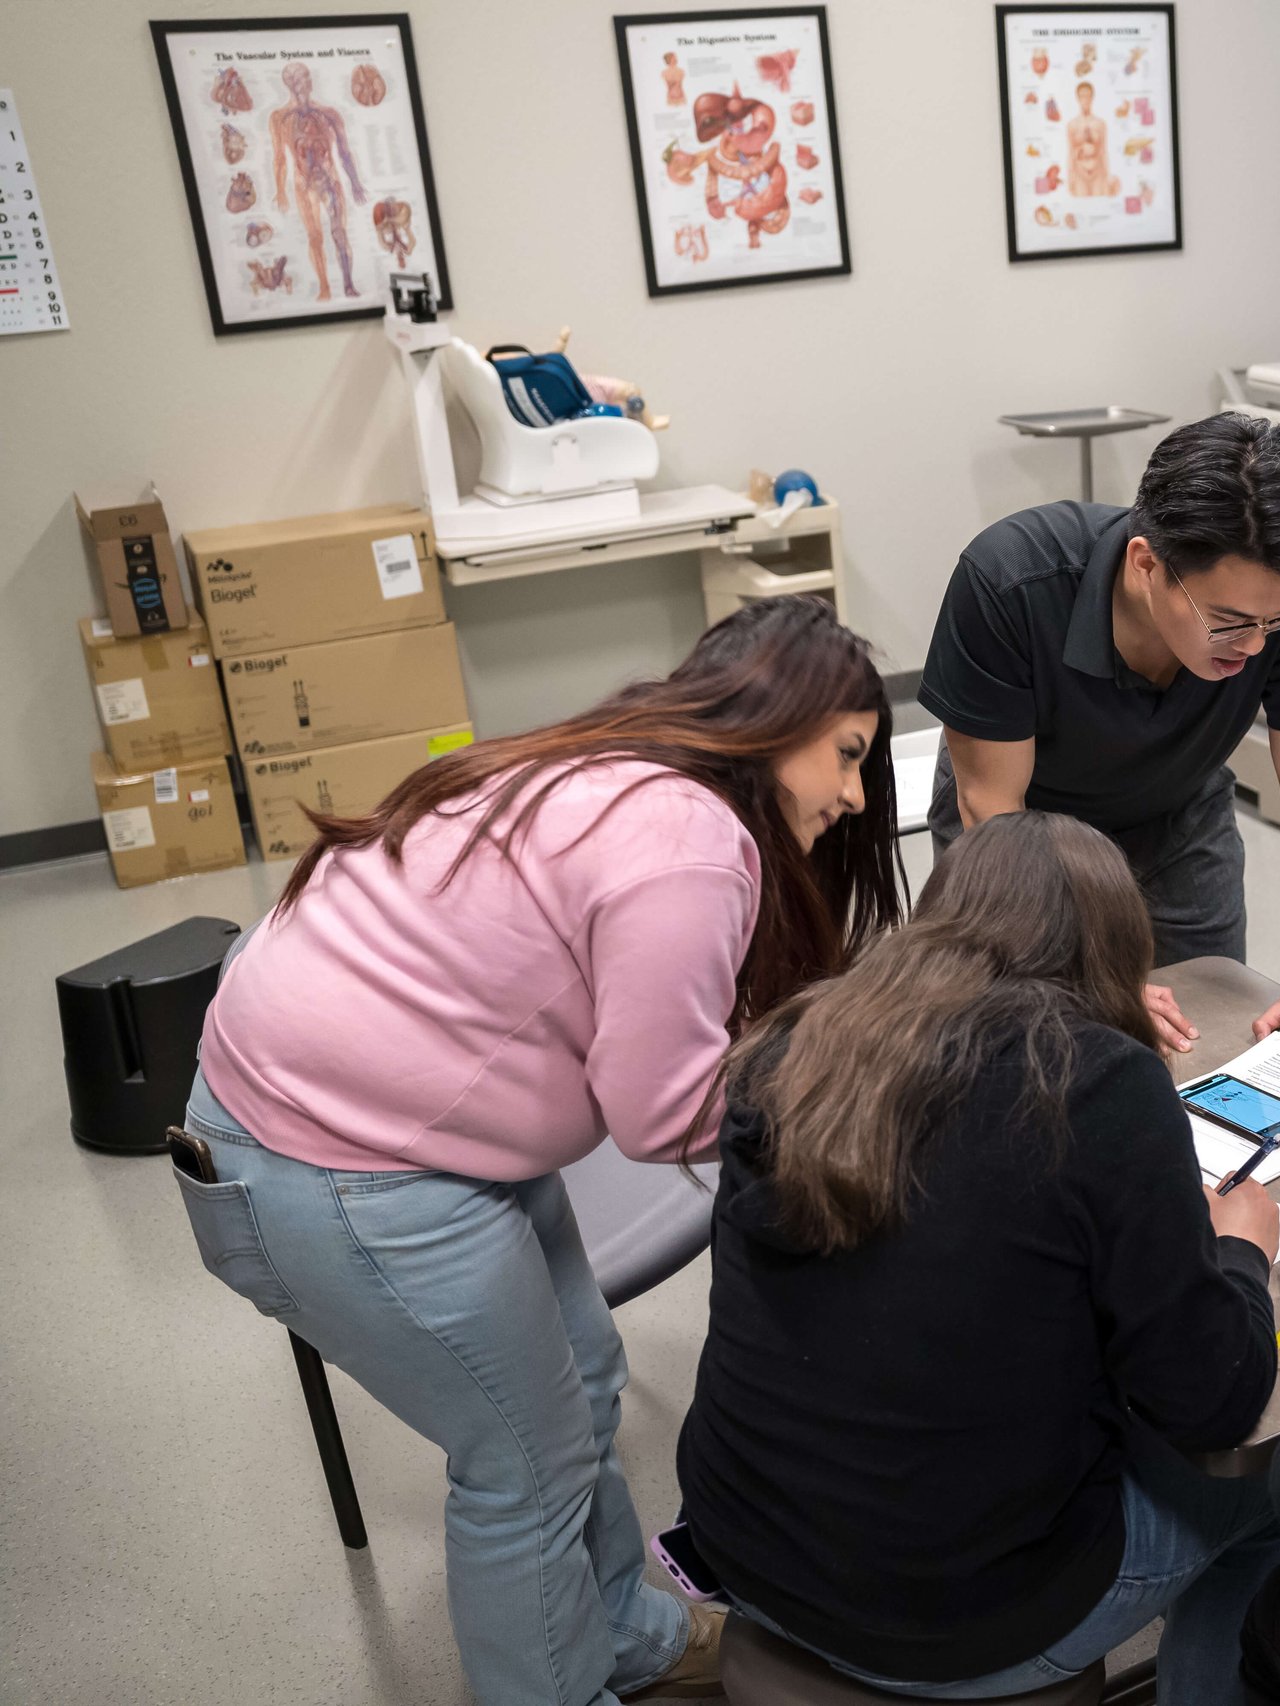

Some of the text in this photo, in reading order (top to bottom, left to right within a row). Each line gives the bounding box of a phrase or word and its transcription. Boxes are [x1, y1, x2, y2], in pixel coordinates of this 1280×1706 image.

[215, 47, 371, 62] The Vascular System and Viscera
[10, 130, 16, 141] 1
[15, 161, 26, 173] 2
[23, 189, 33, 201] 3
[28, 211, 38, 221] 4
[32, 227, 41, 238] 5
[35, 240, 44, 250] 6
[40, 258, 48, 269] 7
[44, 274, 53, 285] 8
[48, 291, 56, 301] 9
[48, 303, 61, 313] 10
[52, 315, 62, 325] 11
[211, 584, 257, 604] Biogel
[244, 655, 288, 673] Biogel
[269, 756, 312, 774] Biogel
